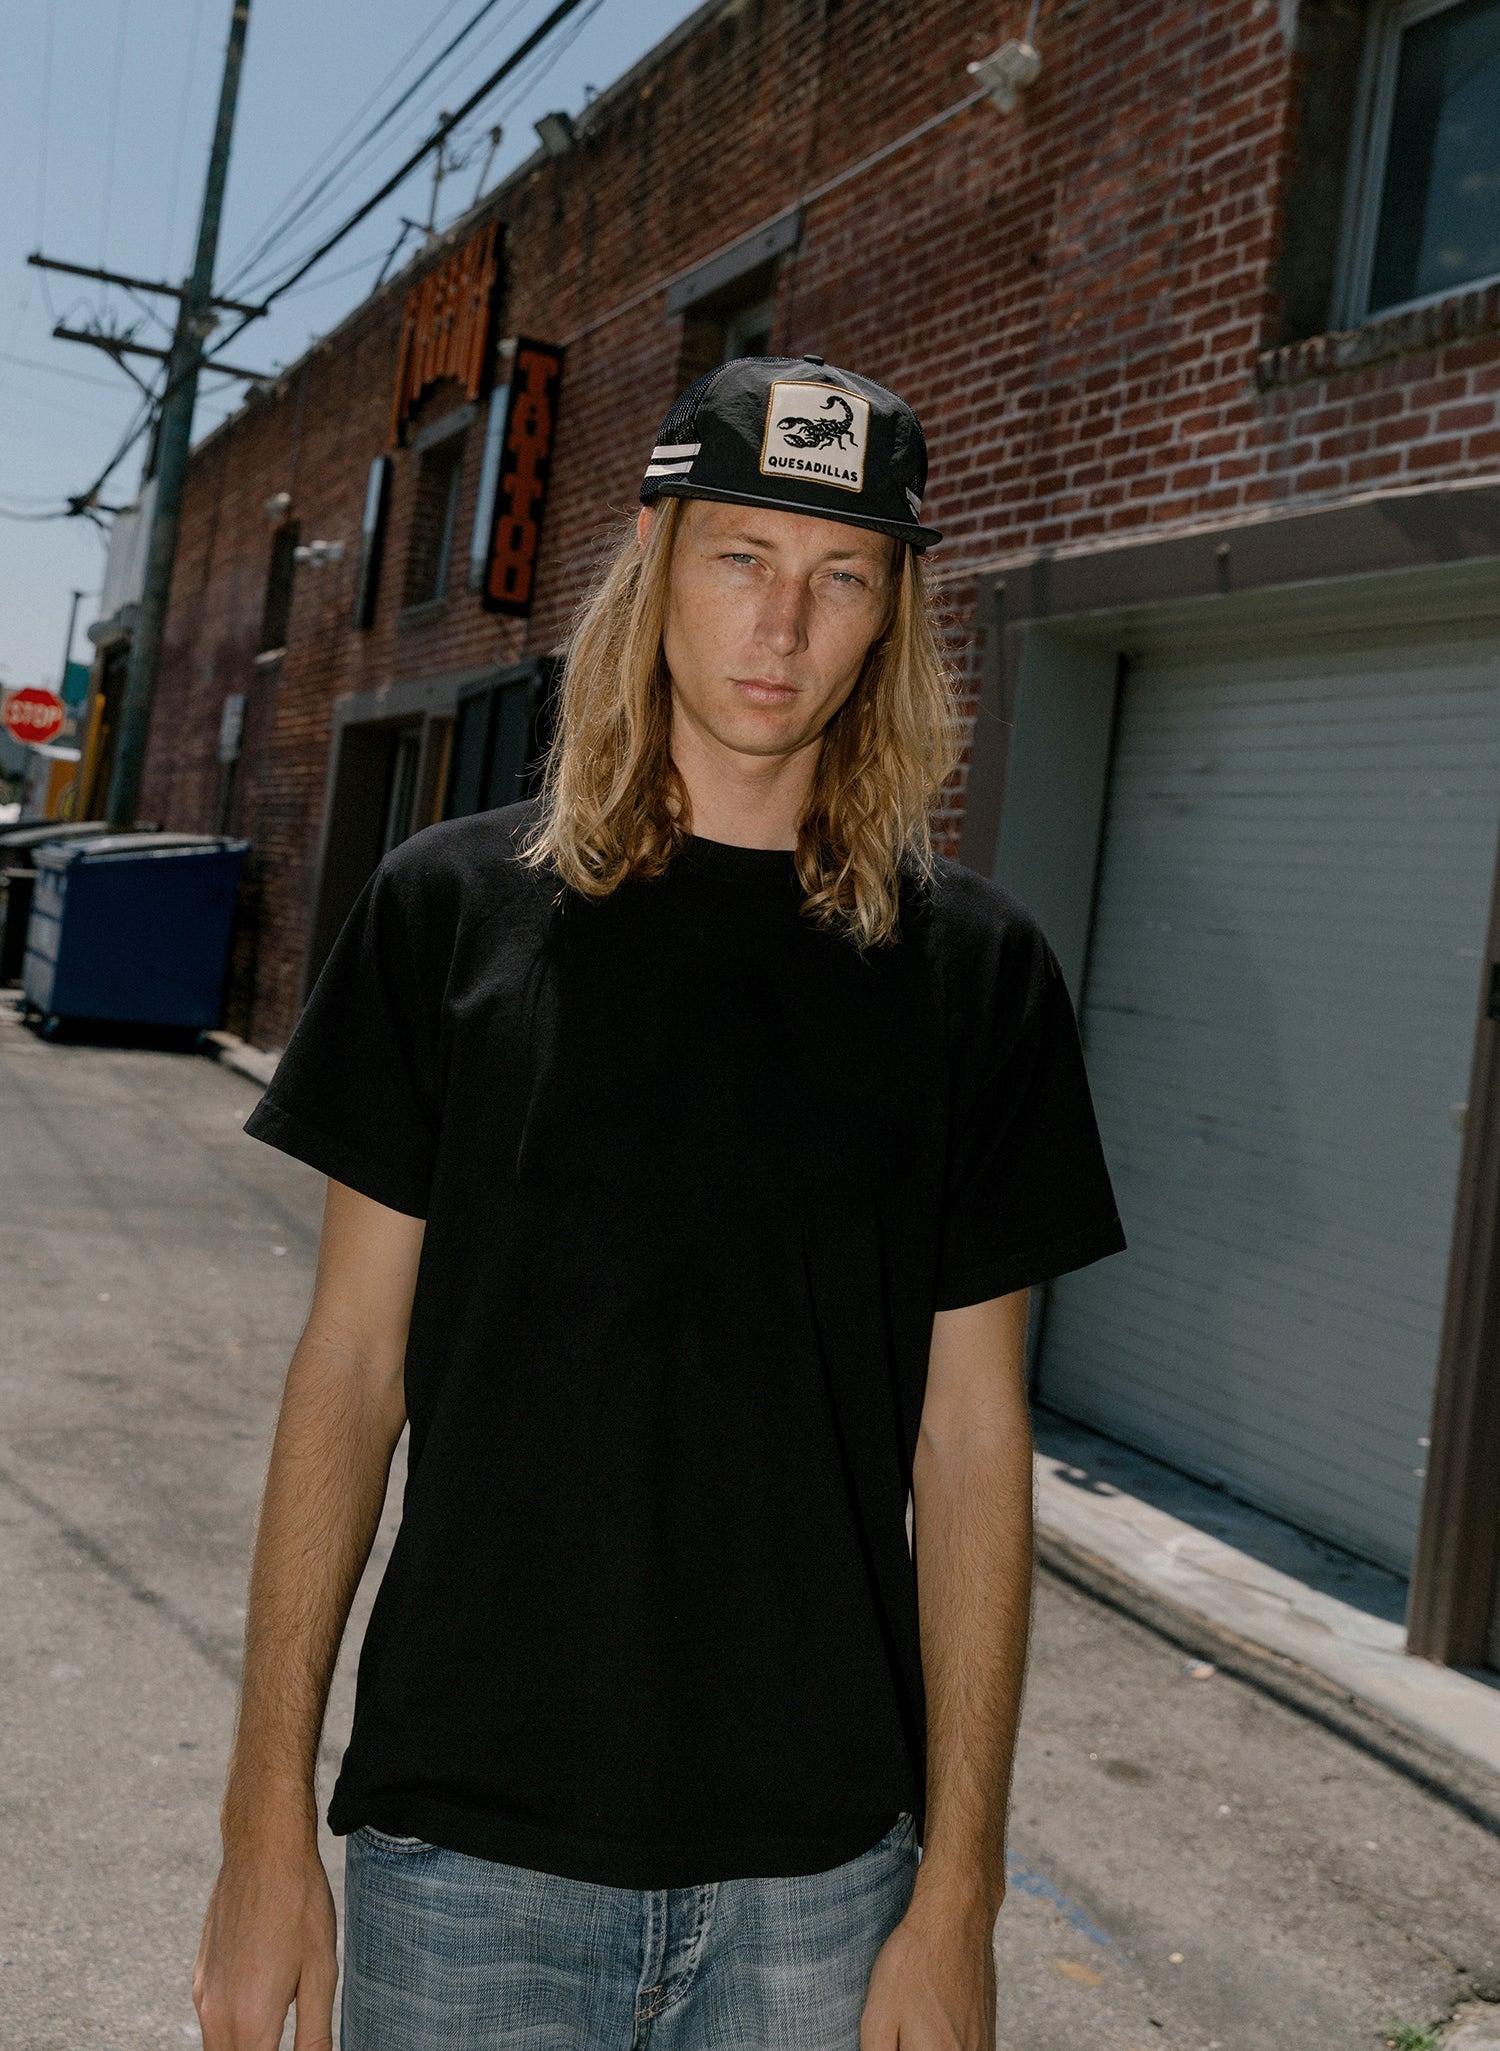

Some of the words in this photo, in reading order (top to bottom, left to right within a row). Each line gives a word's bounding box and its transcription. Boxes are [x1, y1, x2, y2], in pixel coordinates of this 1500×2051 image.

[488, 351, 559, 603] TATTOO
[768, 456, 858, 482] QUESADILLAS
[7, 700, 62, 728] STOP
